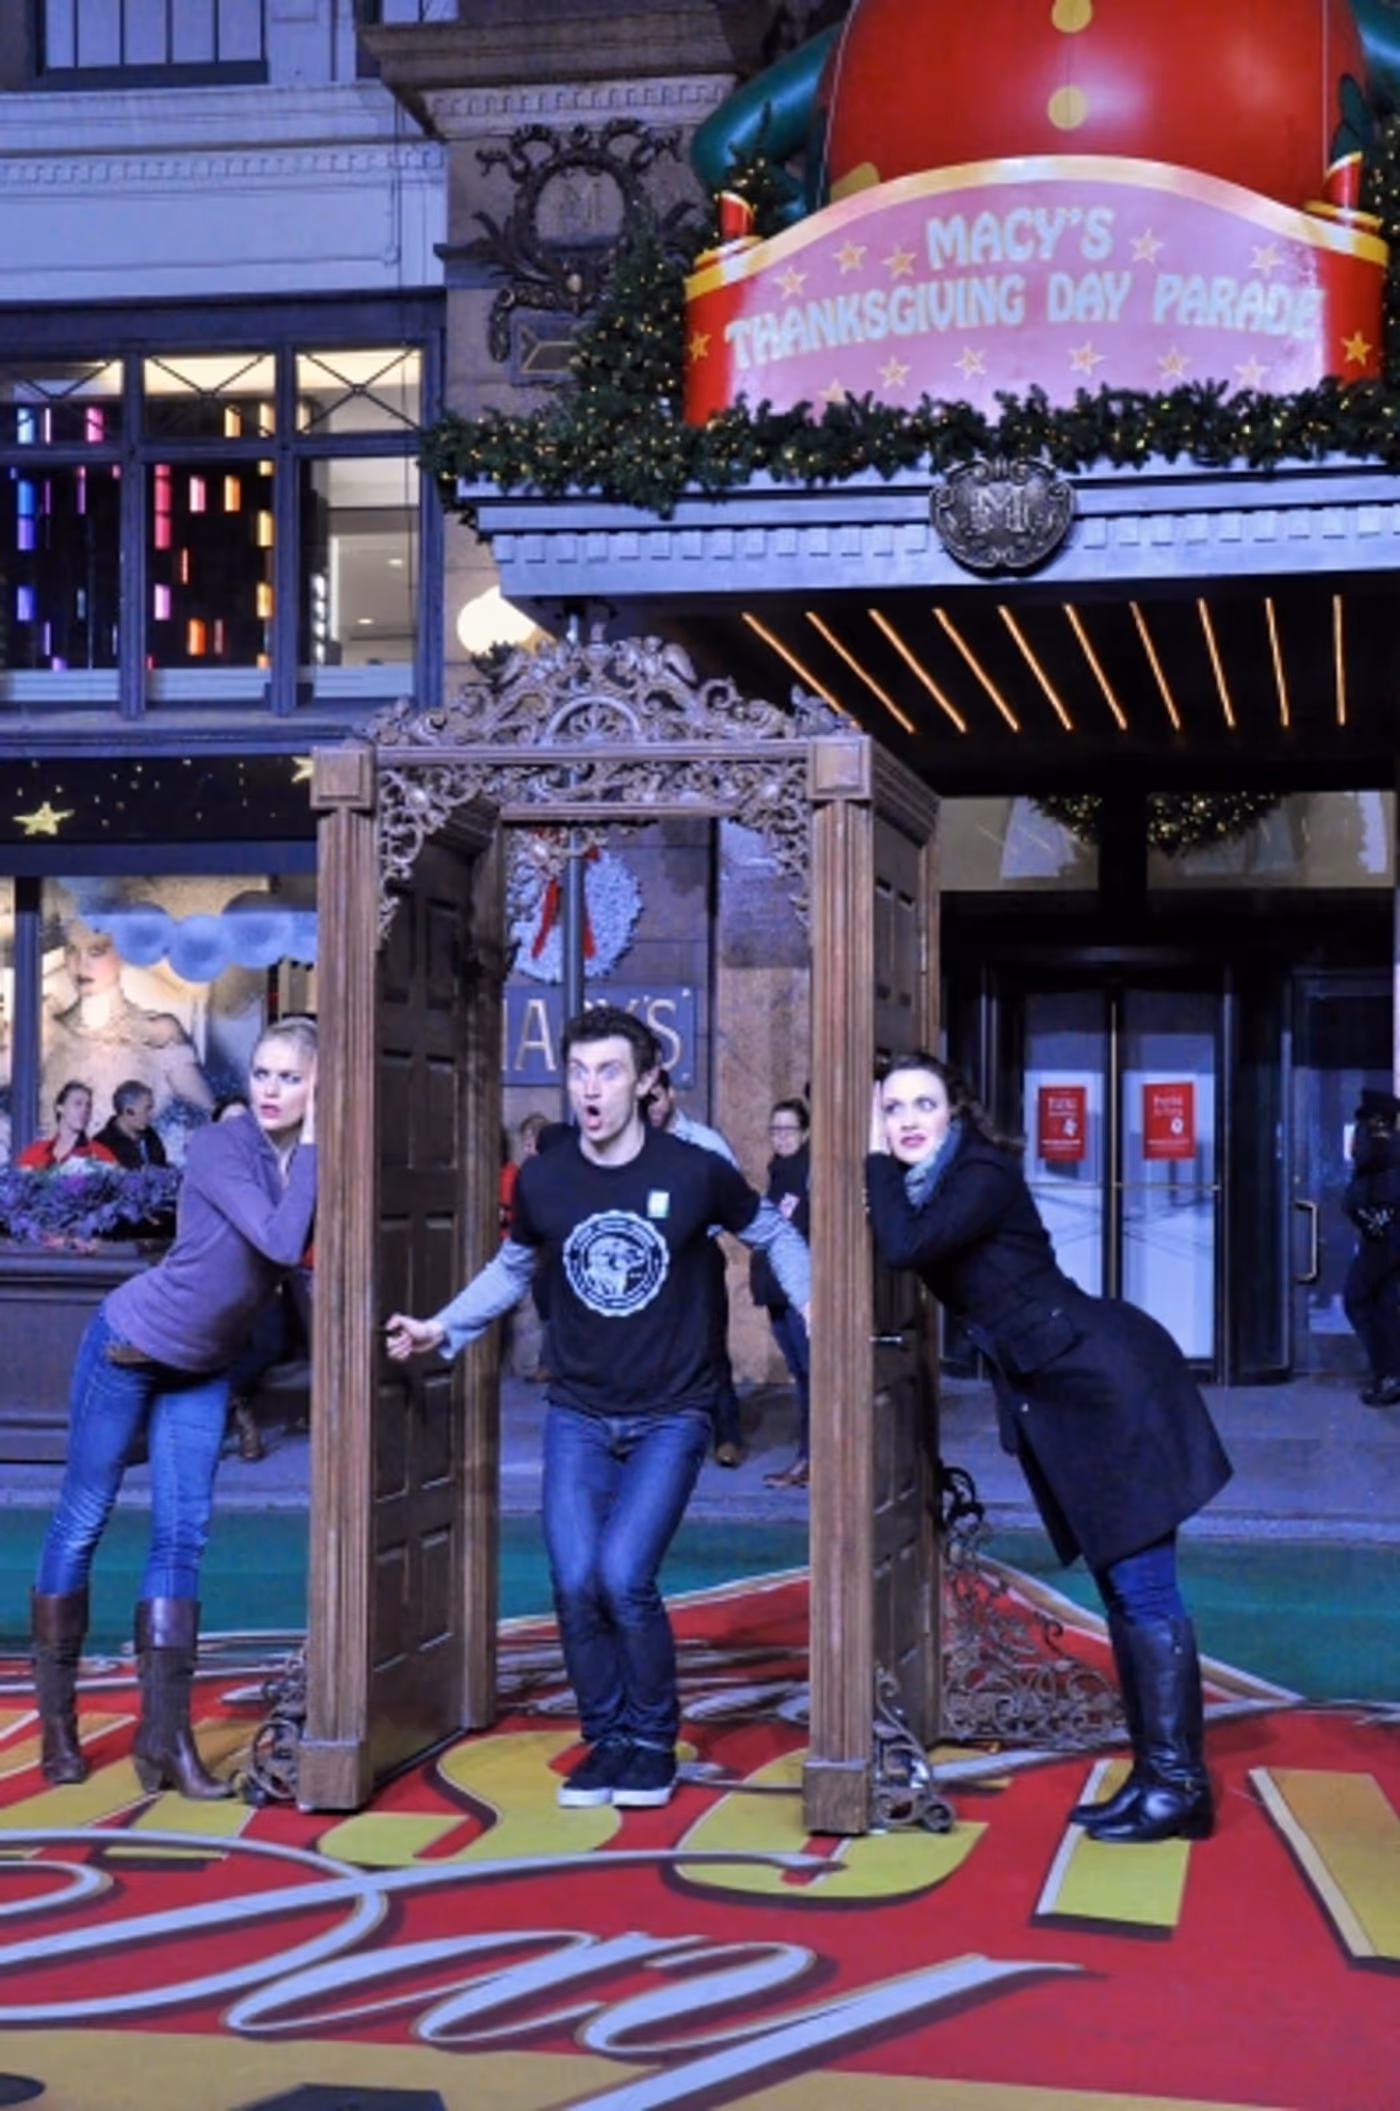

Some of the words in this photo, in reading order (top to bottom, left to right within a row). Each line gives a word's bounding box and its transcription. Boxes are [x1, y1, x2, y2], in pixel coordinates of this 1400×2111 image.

[926, 206, 1114, 270] MACY'S
[724, 273, 1026, 370] THANKSGIVING
[1047, 271, 1131, 323] DAY
[1152, 273, 1326, 341] PARADE
